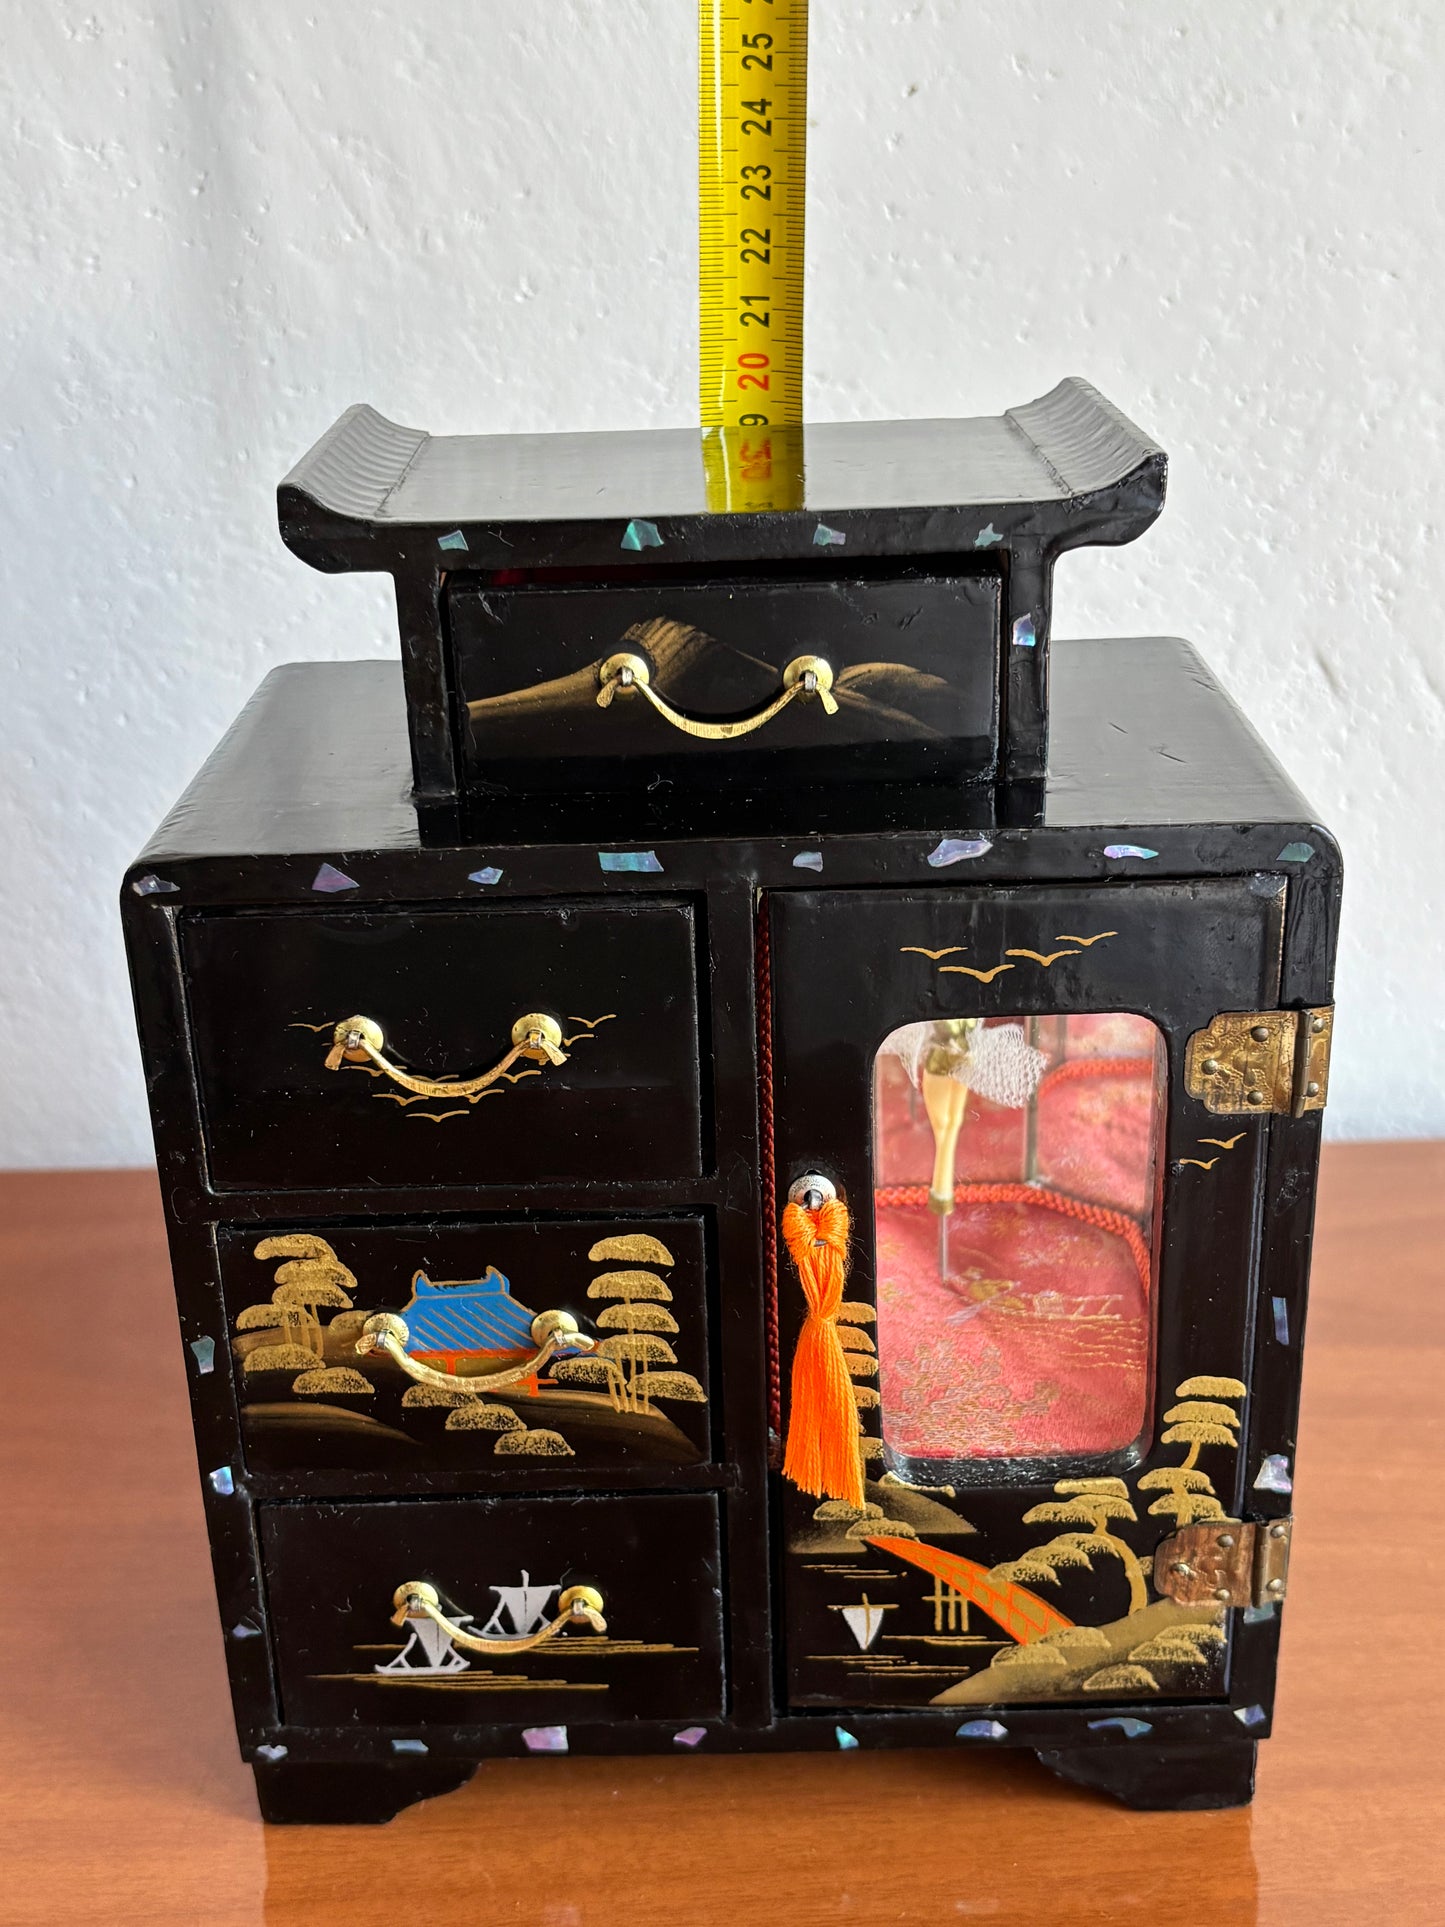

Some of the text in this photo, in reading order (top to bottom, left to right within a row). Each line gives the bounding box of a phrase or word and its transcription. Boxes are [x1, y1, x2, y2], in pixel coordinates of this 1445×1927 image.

[741, 33, 774, 72] 25
[740, 98, 773, 137] 24
[740, 164, 772, 201] 23
[739, 228, 771, 265] 22
[739, 295, 771, 328] 21
[737, 353, 770, 391] 20
